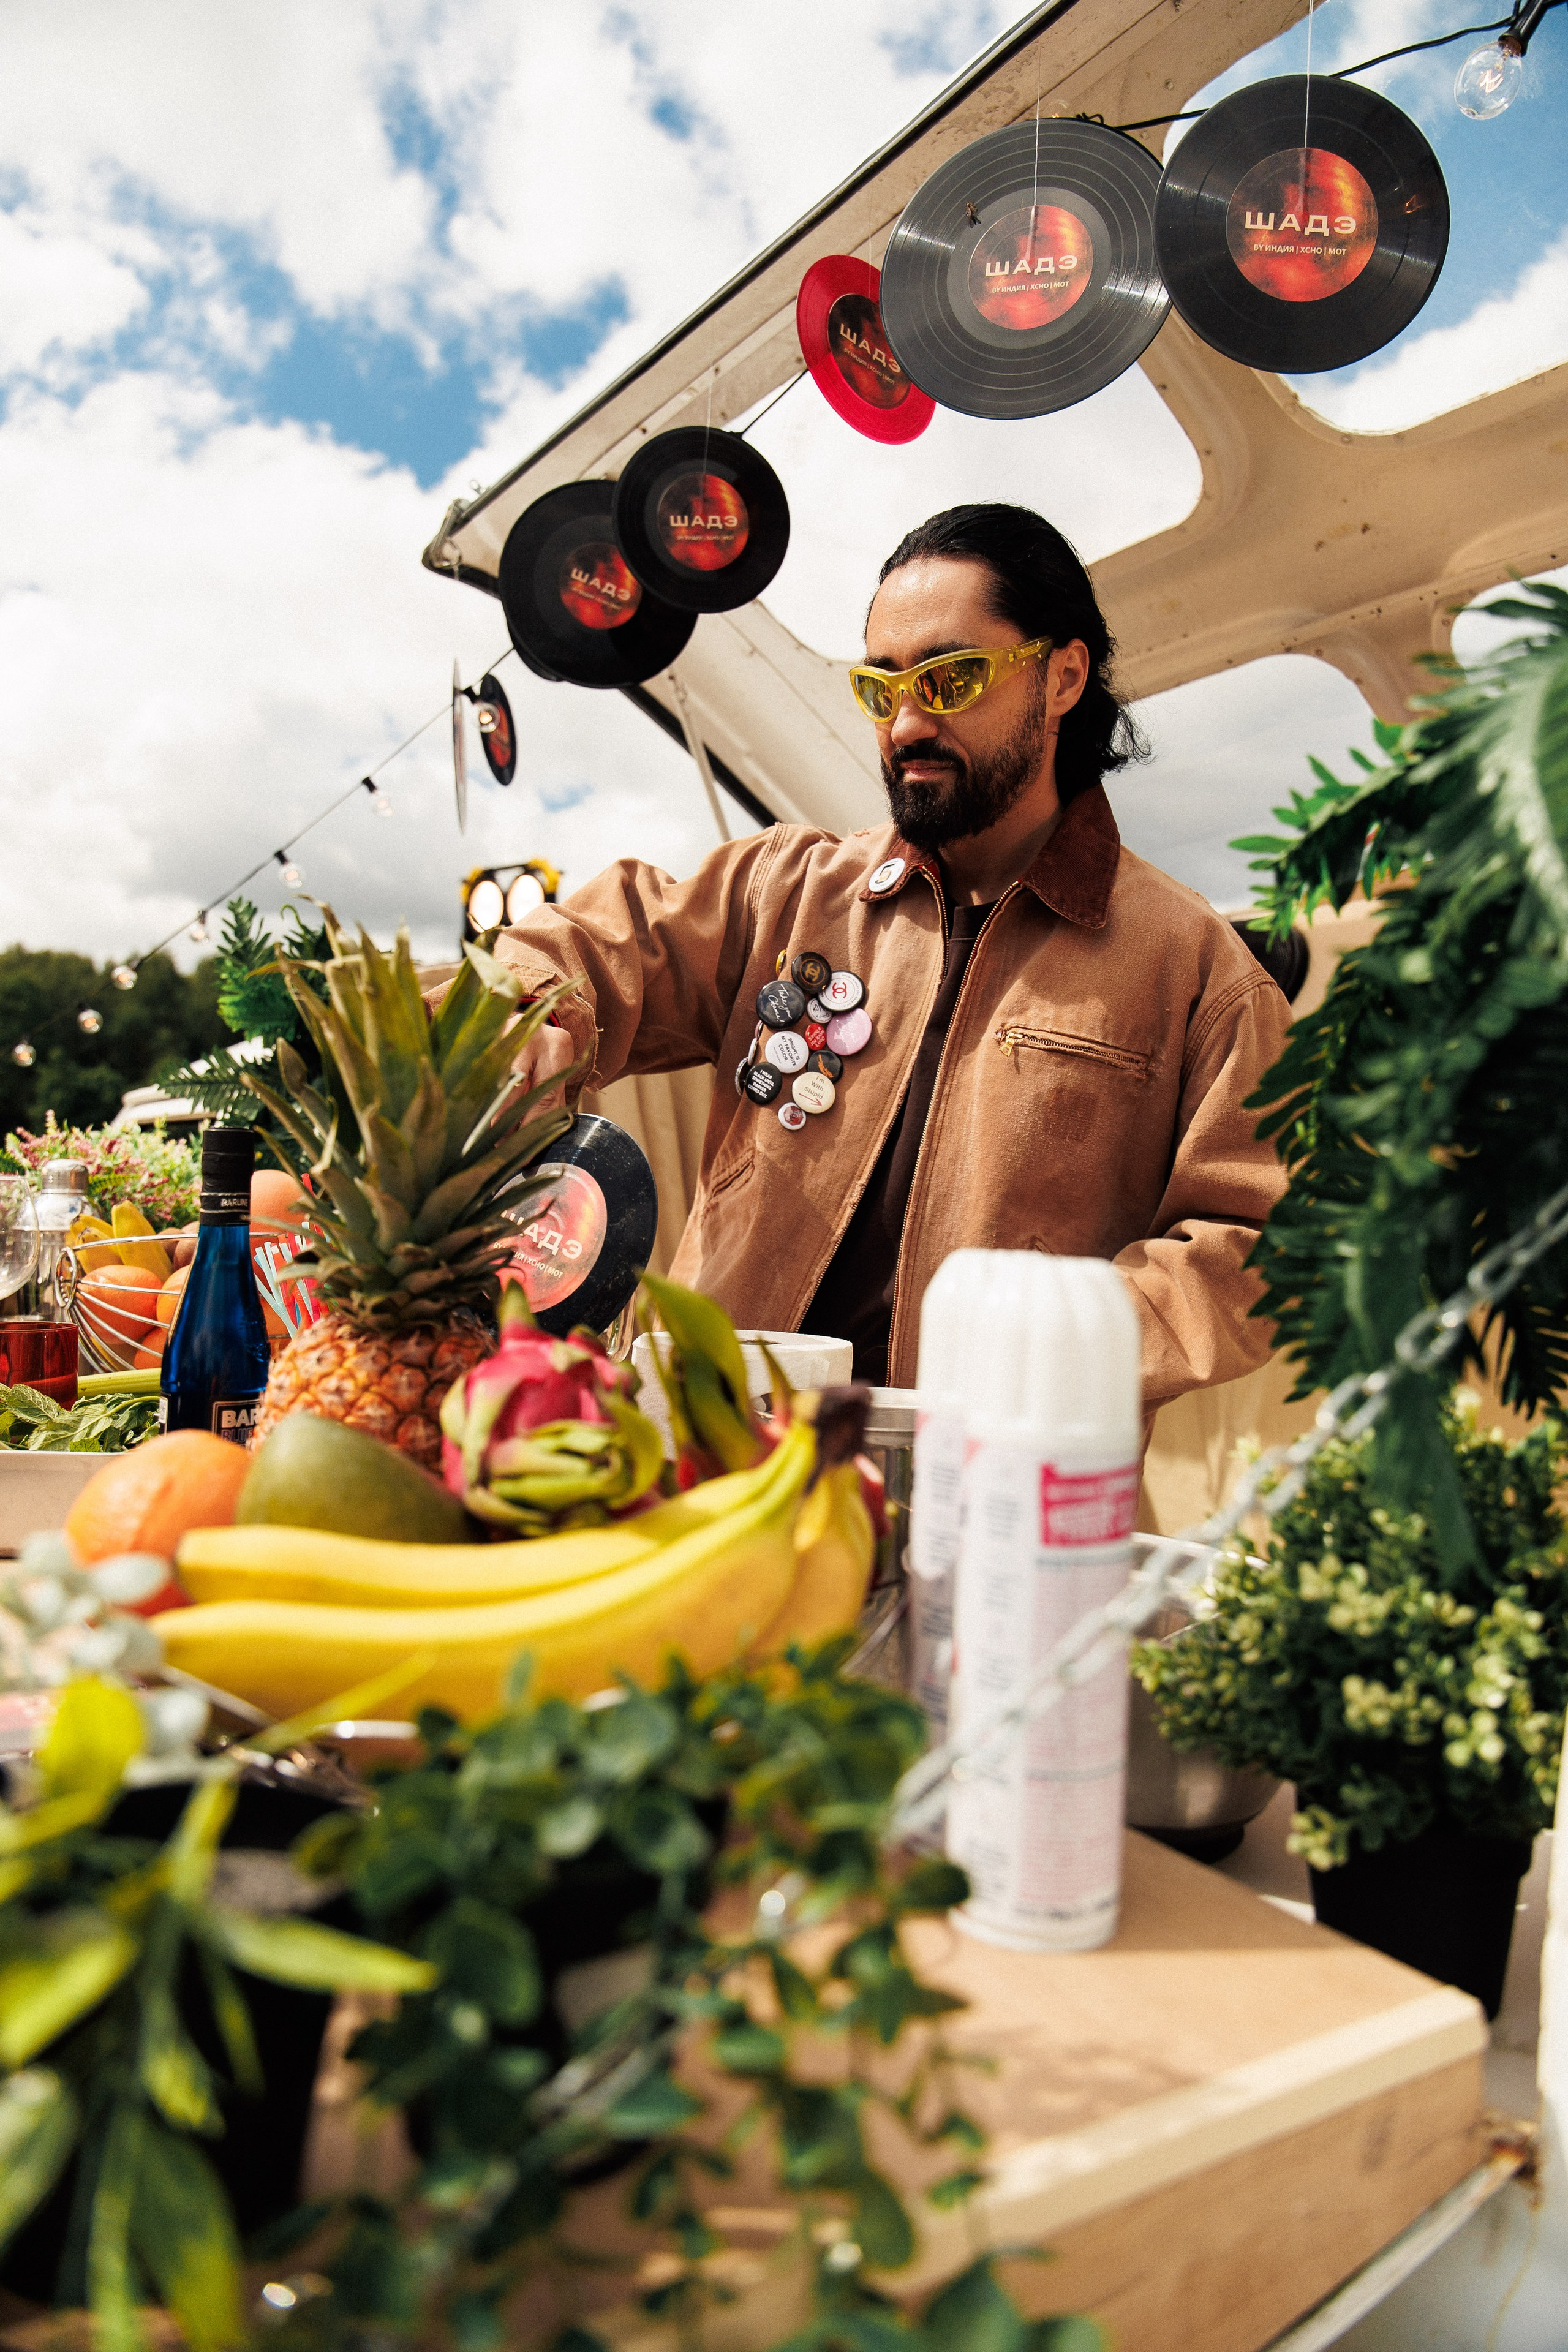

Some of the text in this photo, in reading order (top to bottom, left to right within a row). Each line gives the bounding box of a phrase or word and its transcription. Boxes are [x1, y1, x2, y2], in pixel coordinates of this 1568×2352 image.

[1245, 211, 1357, 237] ШАДЭ
[1265, 245, 1294, 254] ИНДИЯ
[986, 255, 1077, 277] ШАДЭ
[840, 323, 902, 373] ШАДЭ
[669, 515, 739, 530] ШАДЭ
[571, 567, 631, 601] ШАДЭ
[778, 983, 790, 1006] Take
[788, 1038, 798, 1055] BRIGHT
[785, 1044, 797, 1067] FAVORITE
[752, 1075, 772, 1090] SOMETHING
[753, 1071, 774, 1087] BLACK UNTIL
[762, 1071, 772, 1080] WEAR
[748, 1084, 760, 1094] COMES
[753, 1081, 767, 1093] DARKER
[804, 1086, 823, 1099] Stupid
[811, 1080, 824, 1091] With
[548, 1267, 564, 1278] МОТ
[221, 1408, 258, 1428] BAR
